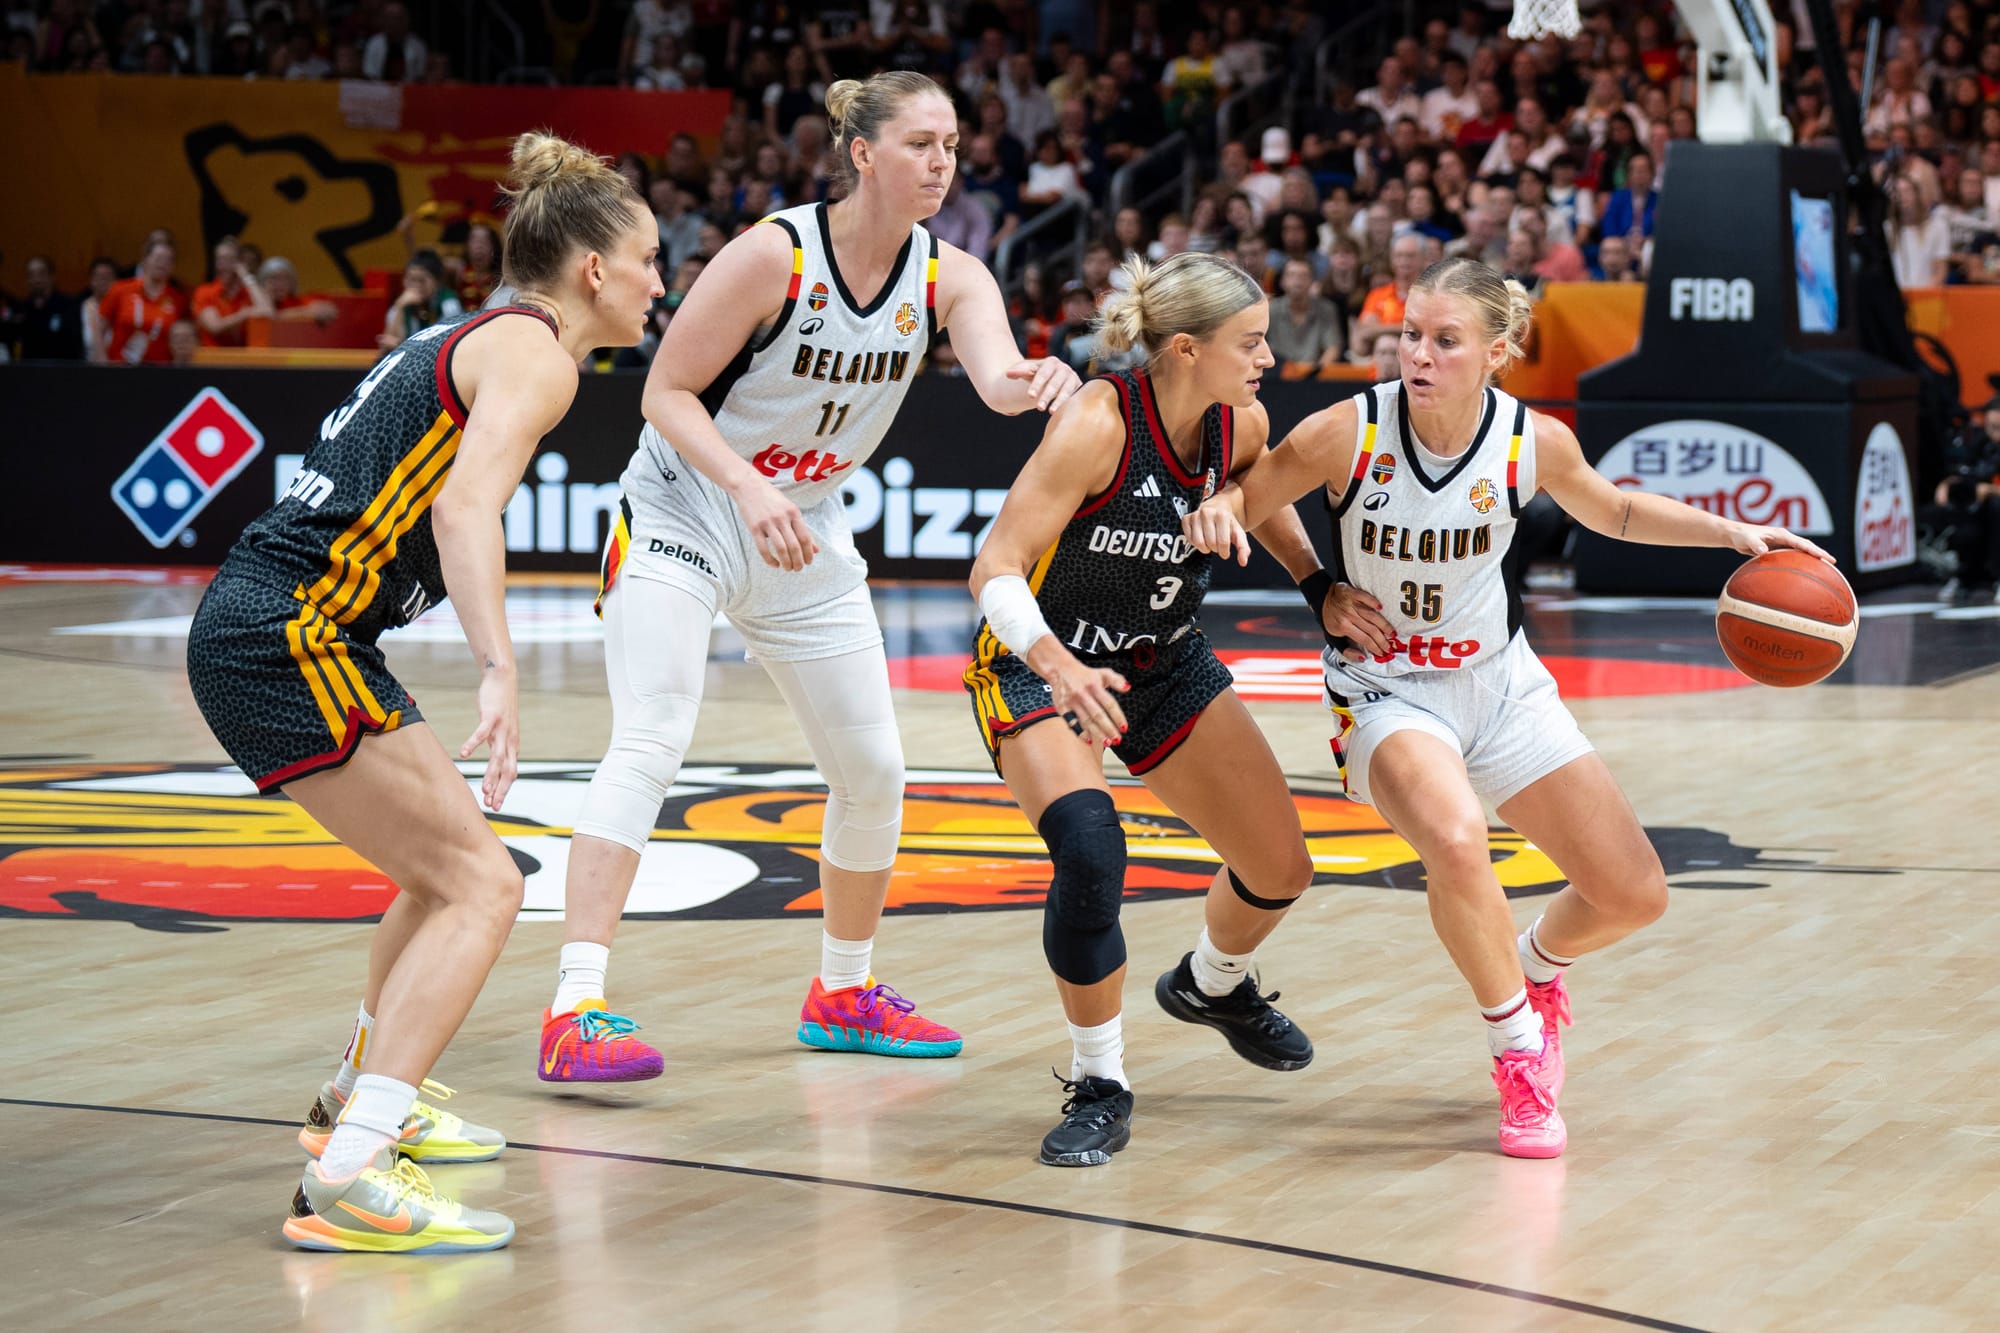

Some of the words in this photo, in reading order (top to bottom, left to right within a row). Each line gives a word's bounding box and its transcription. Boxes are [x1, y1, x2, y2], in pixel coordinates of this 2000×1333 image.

[1670, 278, 1754, 321] FIBA
[792, 343, 911, 385] BELGIUM
[815, 400, 850, 437] 11
[1632, 439, 1763, 477] 百岁山
[1089, 525, 1196, 564] DEUTSC
[1361, 519, 1492, 563] BELGIUM
[402, 580, 431, 620] IN
[1150, 576, 1183, 610] 3
[1400, 581, 1443, 623] 35
[1373, 635, 1480, 669] otto
[1743, 636, 1804, 661] molten
